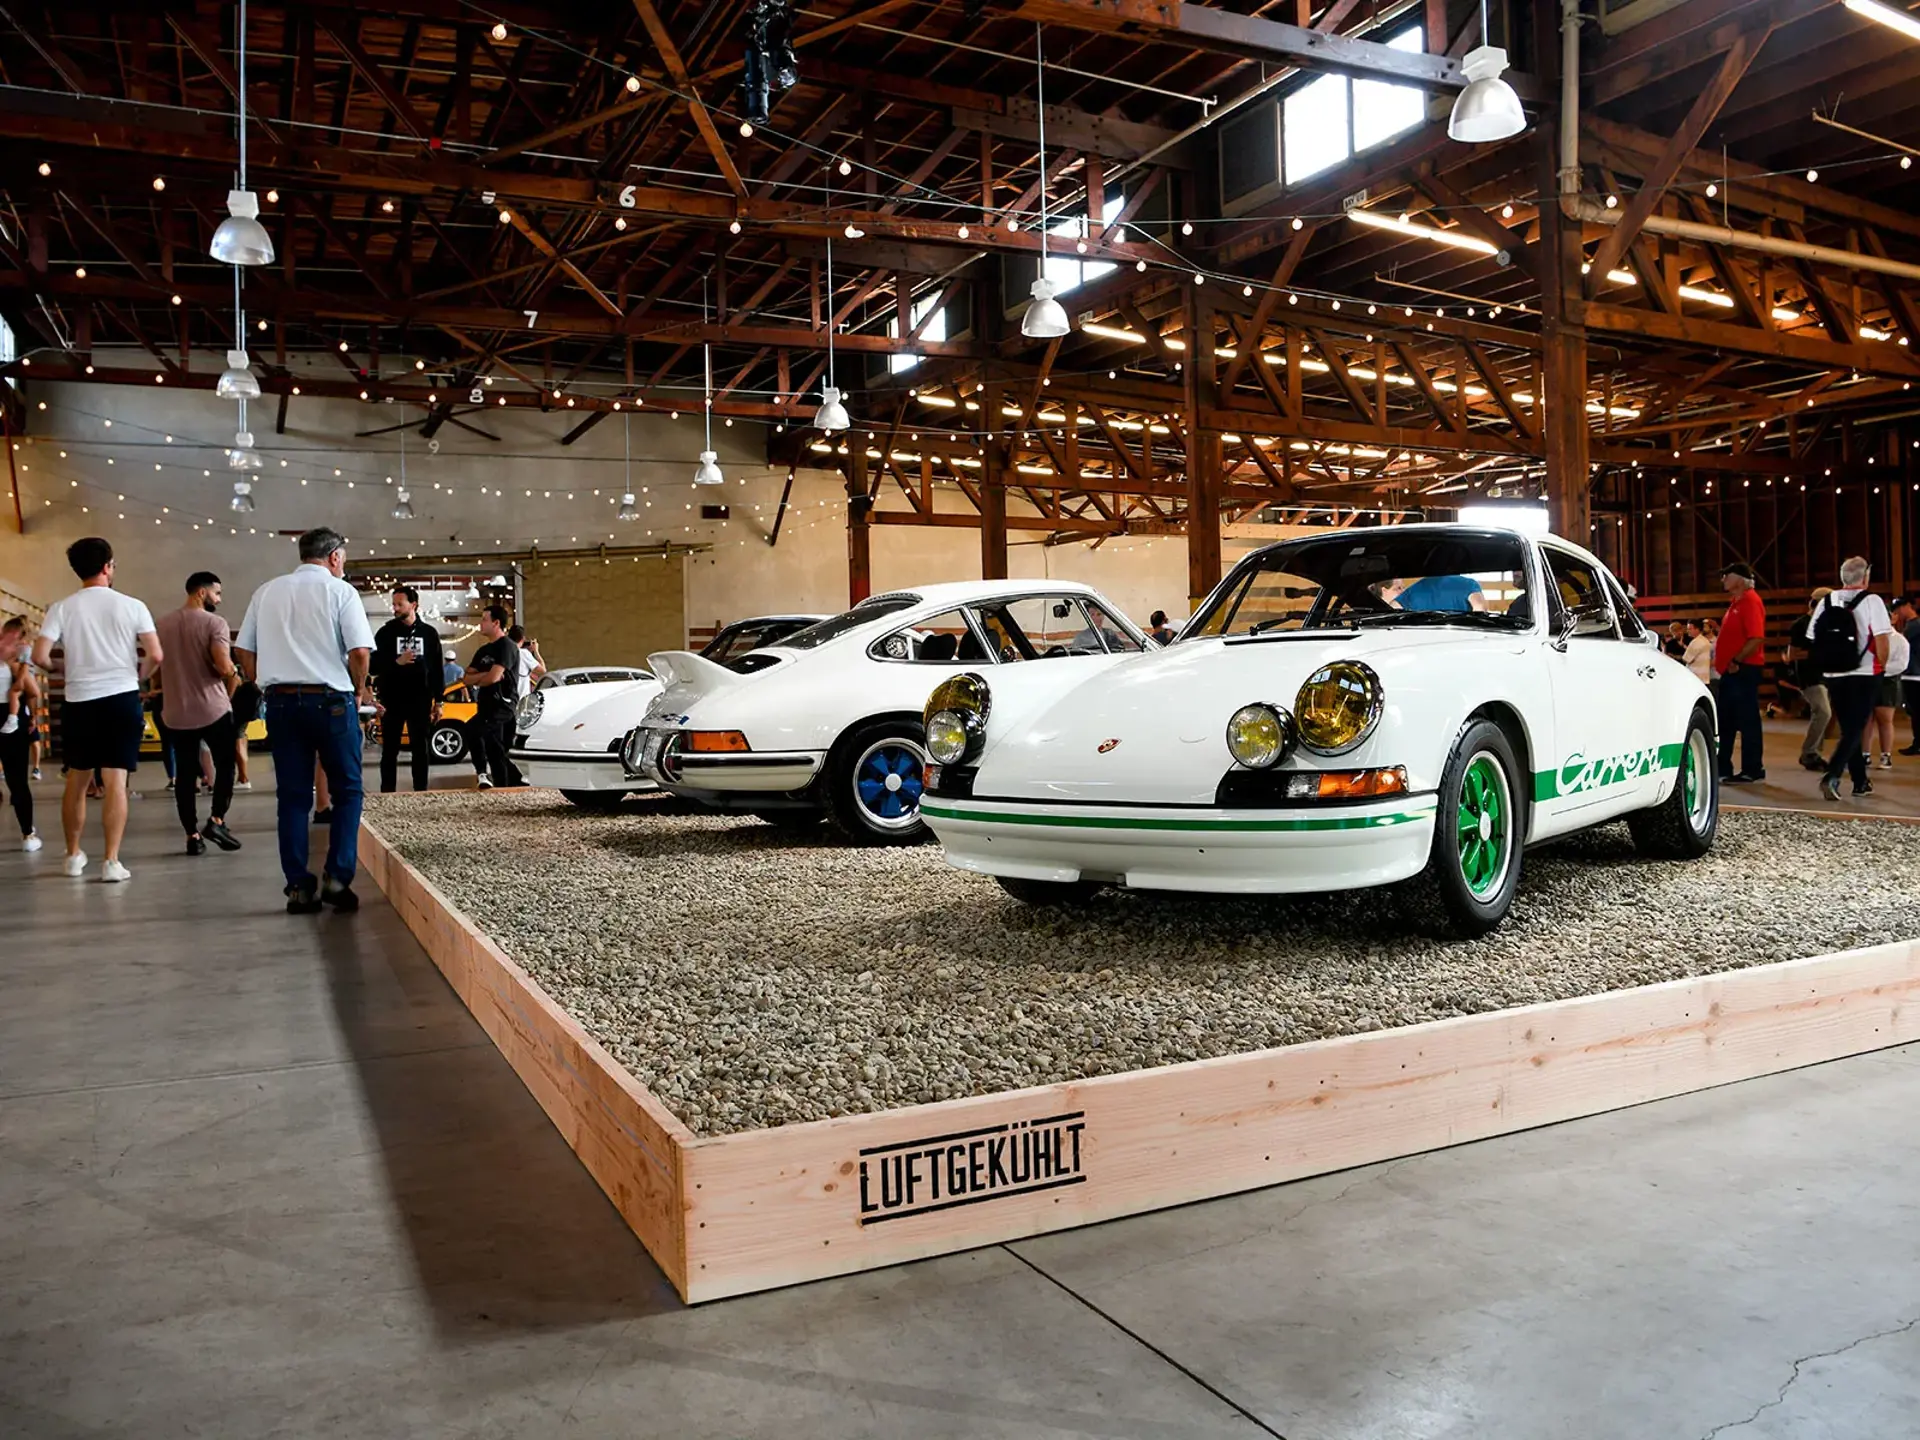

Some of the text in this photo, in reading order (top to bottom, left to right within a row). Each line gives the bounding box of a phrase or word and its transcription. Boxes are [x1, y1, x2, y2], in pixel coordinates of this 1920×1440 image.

[619, 185, 636, 208] 6
[523, 310, 538, 328] 7
[469, 388, 484, 403] 8
[428, 440, 440, 453] 9
[1556, 745, 1664, 796] Carrera
[860, 1121, 1085, 1212] LUFTGEKÜHLT
